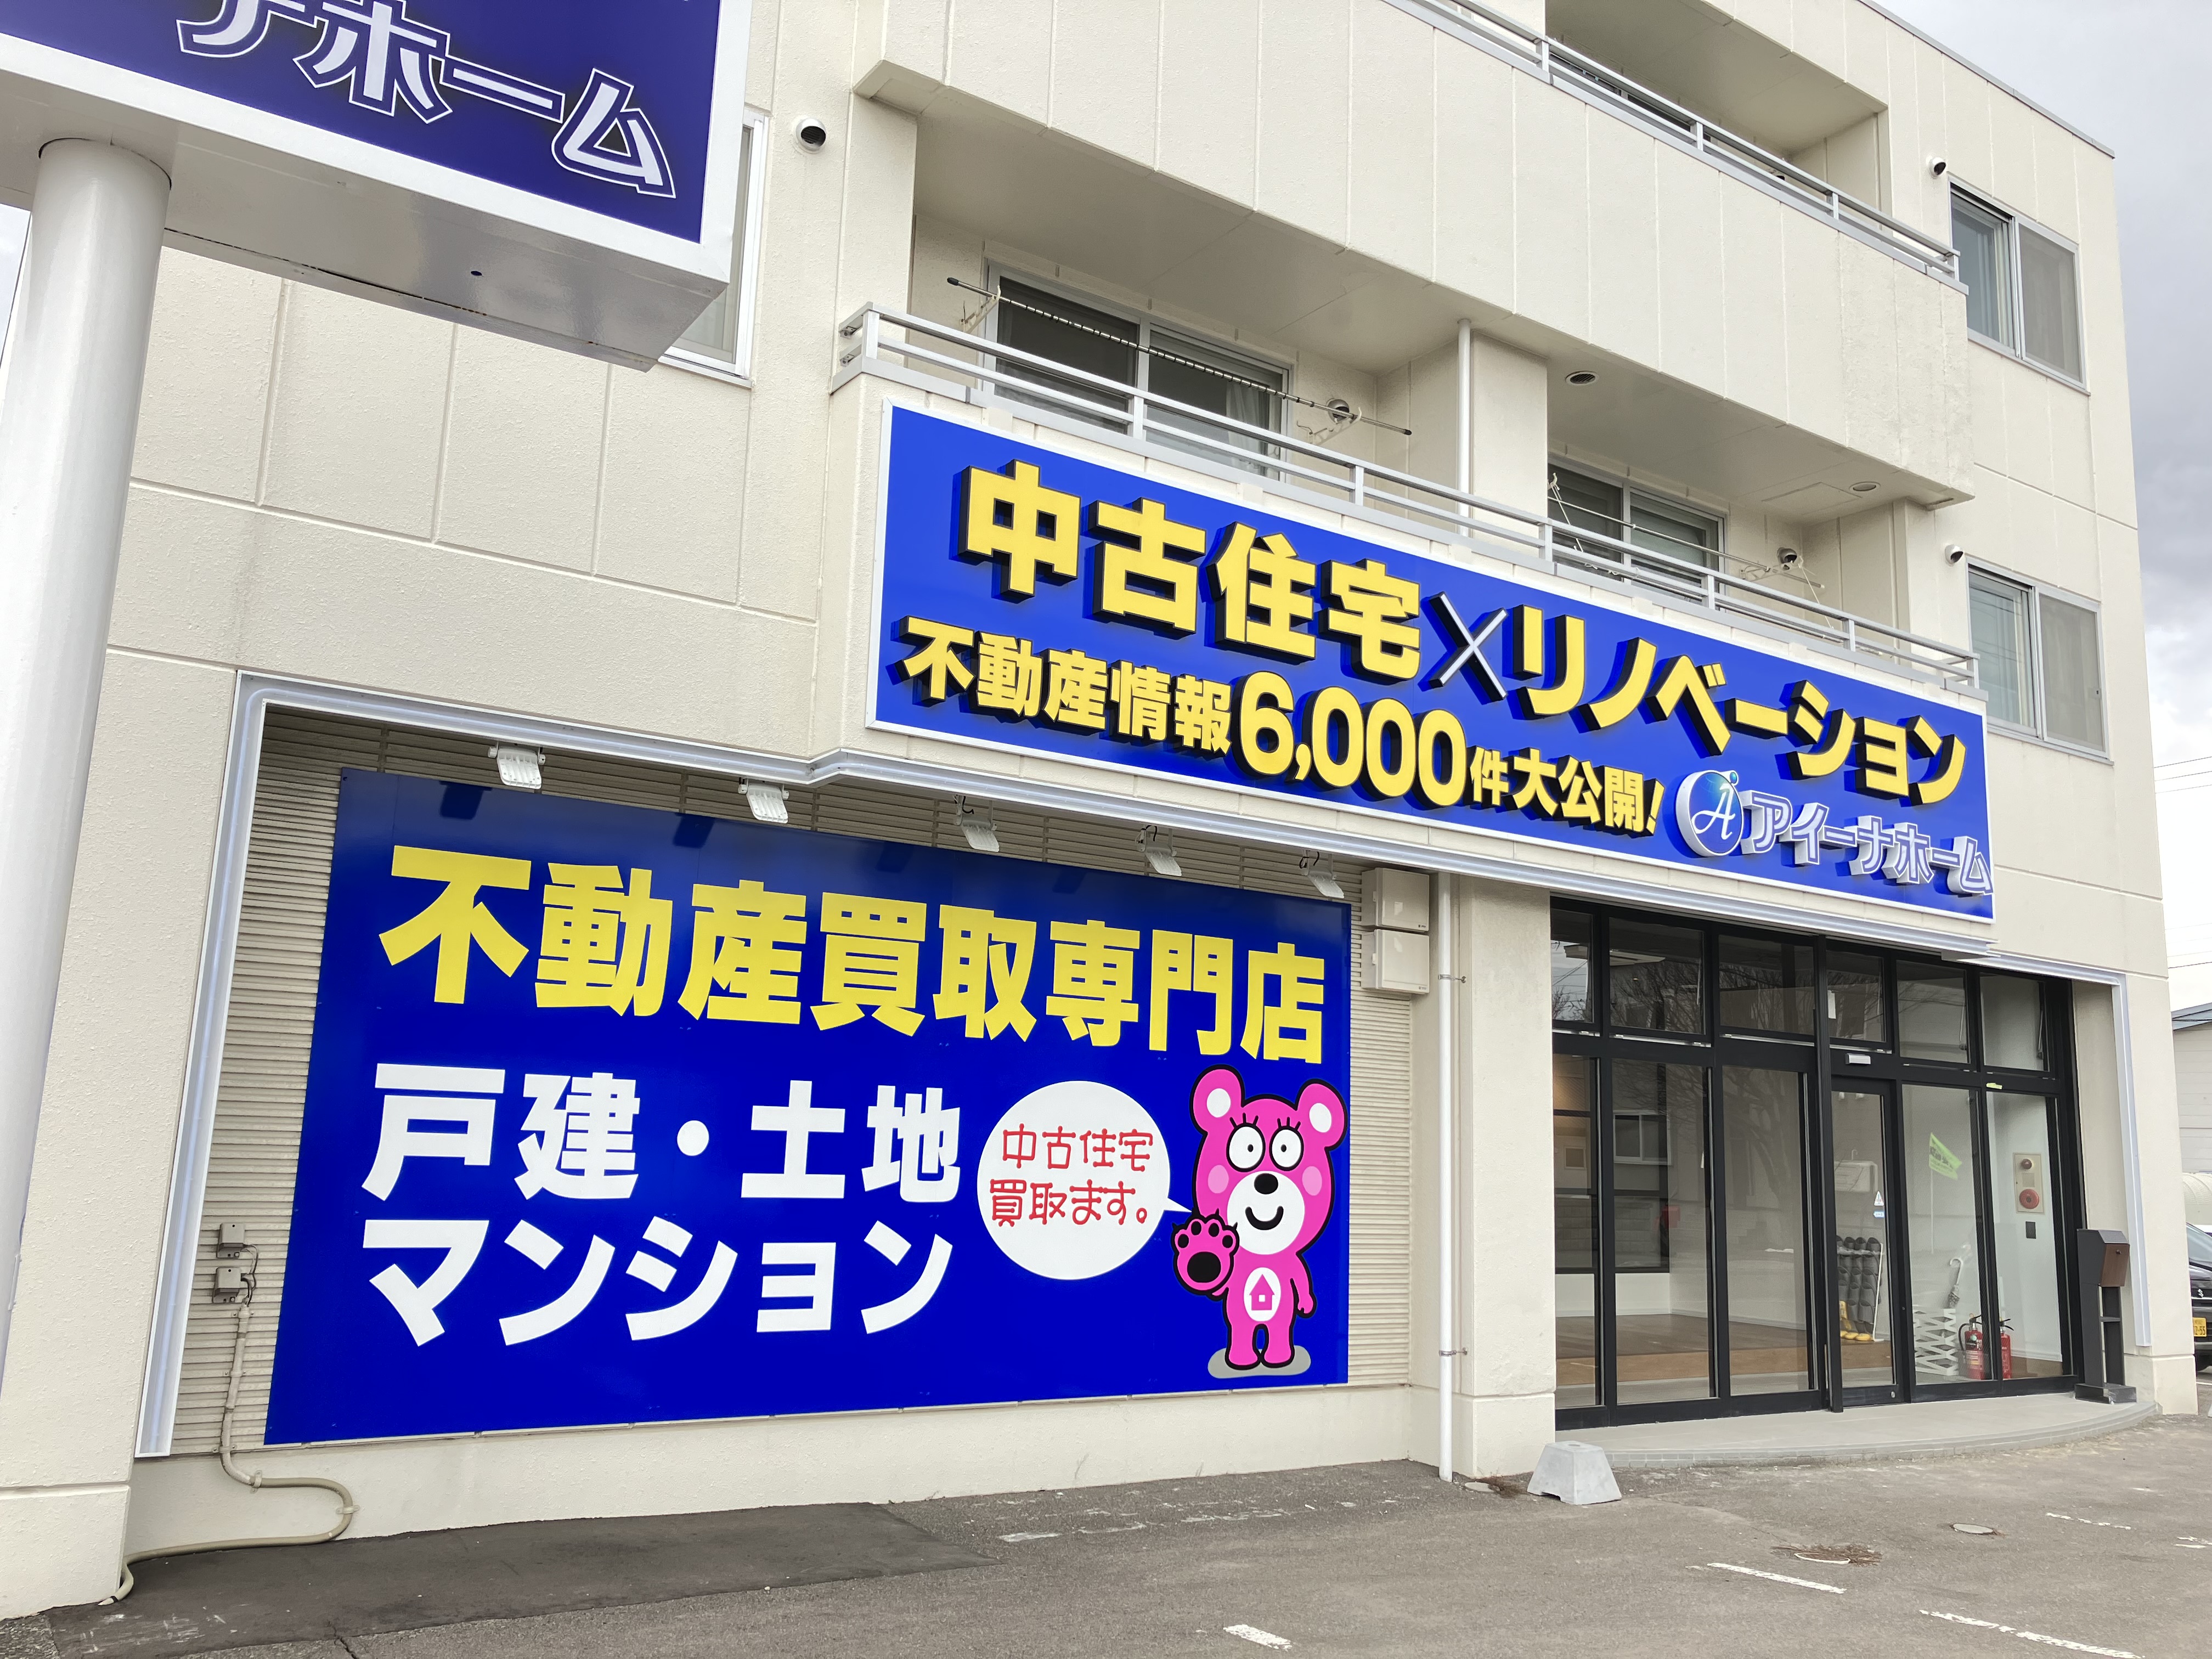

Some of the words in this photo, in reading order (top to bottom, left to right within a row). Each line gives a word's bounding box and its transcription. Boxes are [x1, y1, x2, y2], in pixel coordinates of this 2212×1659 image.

[1747, 789, 1995, 896] アイーナホーム
[379, 845, 1325, 1064] 不動産買取専門店
[1001, 1122, 1154, 1172] 中古住宅
[989, 1178, 1148, 1228] 買取ます。
[361, 1216, 953, 1347] マンション
